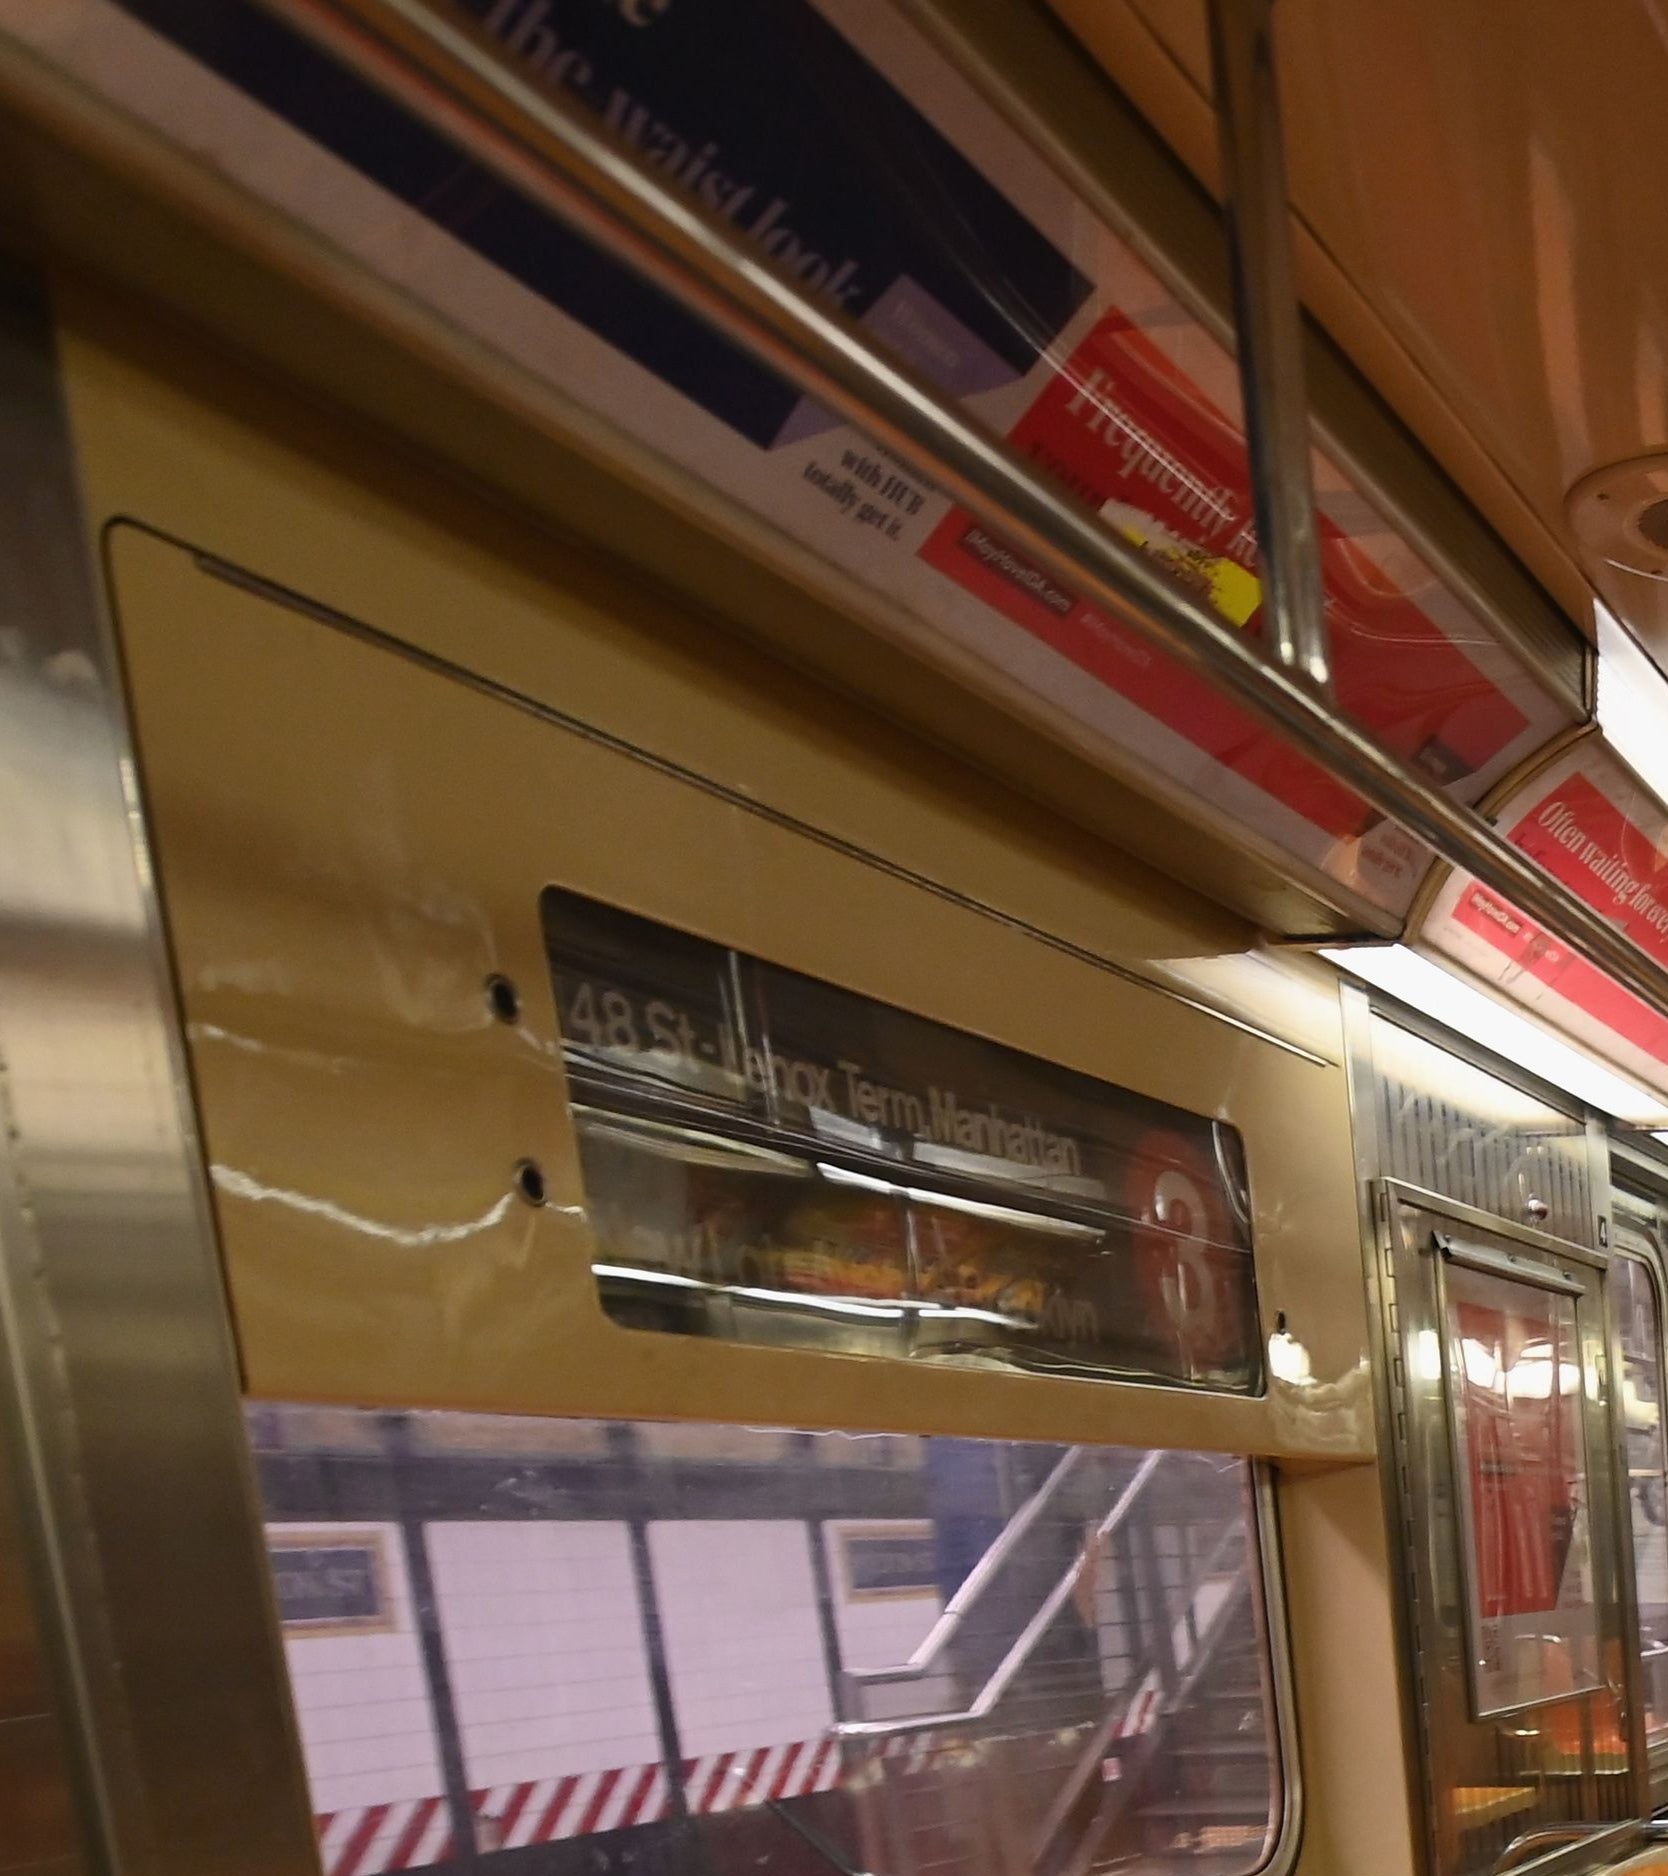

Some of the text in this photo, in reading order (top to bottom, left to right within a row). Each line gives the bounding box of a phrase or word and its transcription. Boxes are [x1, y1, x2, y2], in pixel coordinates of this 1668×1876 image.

[1537, 800, 1587, 853] Often
[1578, 840, 1637, 905] waiting
[1628, 884, 1654, 916] for
[1153, 1171, 1214, 1338] 3
